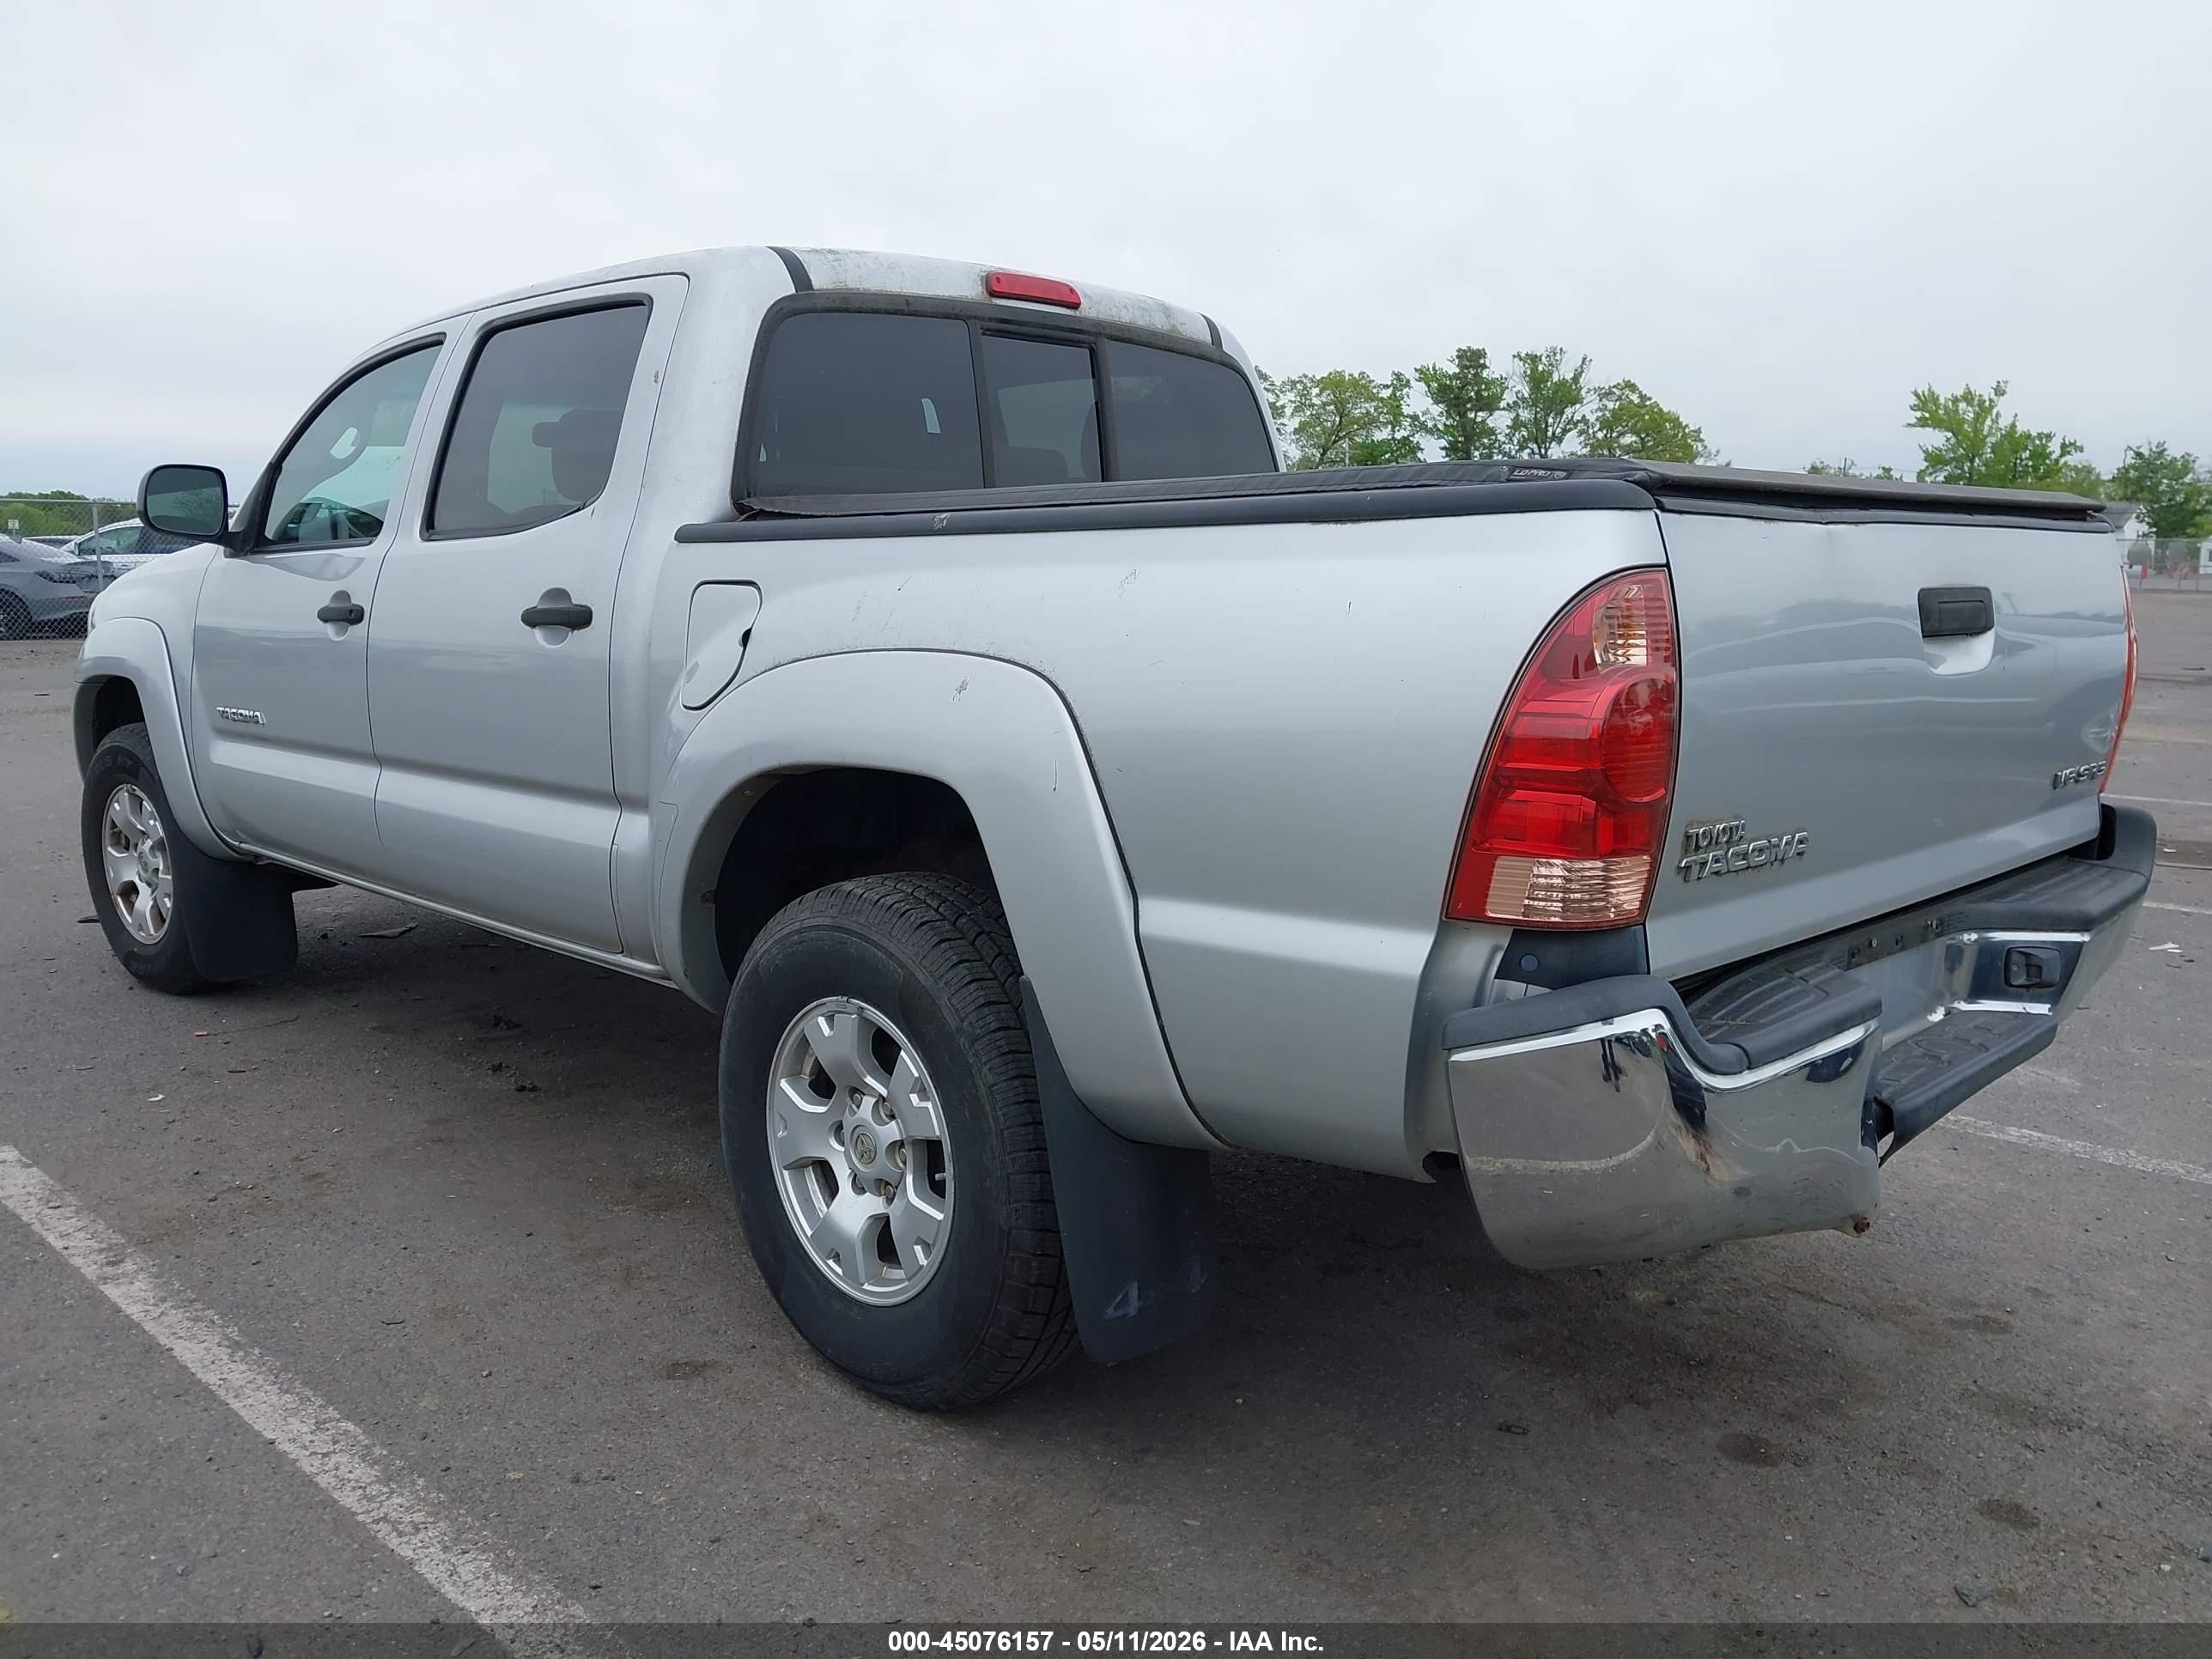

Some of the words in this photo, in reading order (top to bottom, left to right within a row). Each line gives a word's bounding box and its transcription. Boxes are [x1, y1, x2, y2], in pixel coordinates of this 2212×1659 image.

[216, 706, 266, 725] TACOMA
[1688, 820, 1746, 849] TOYOTA
[1680, 831, 1808, 881] TACOMA
